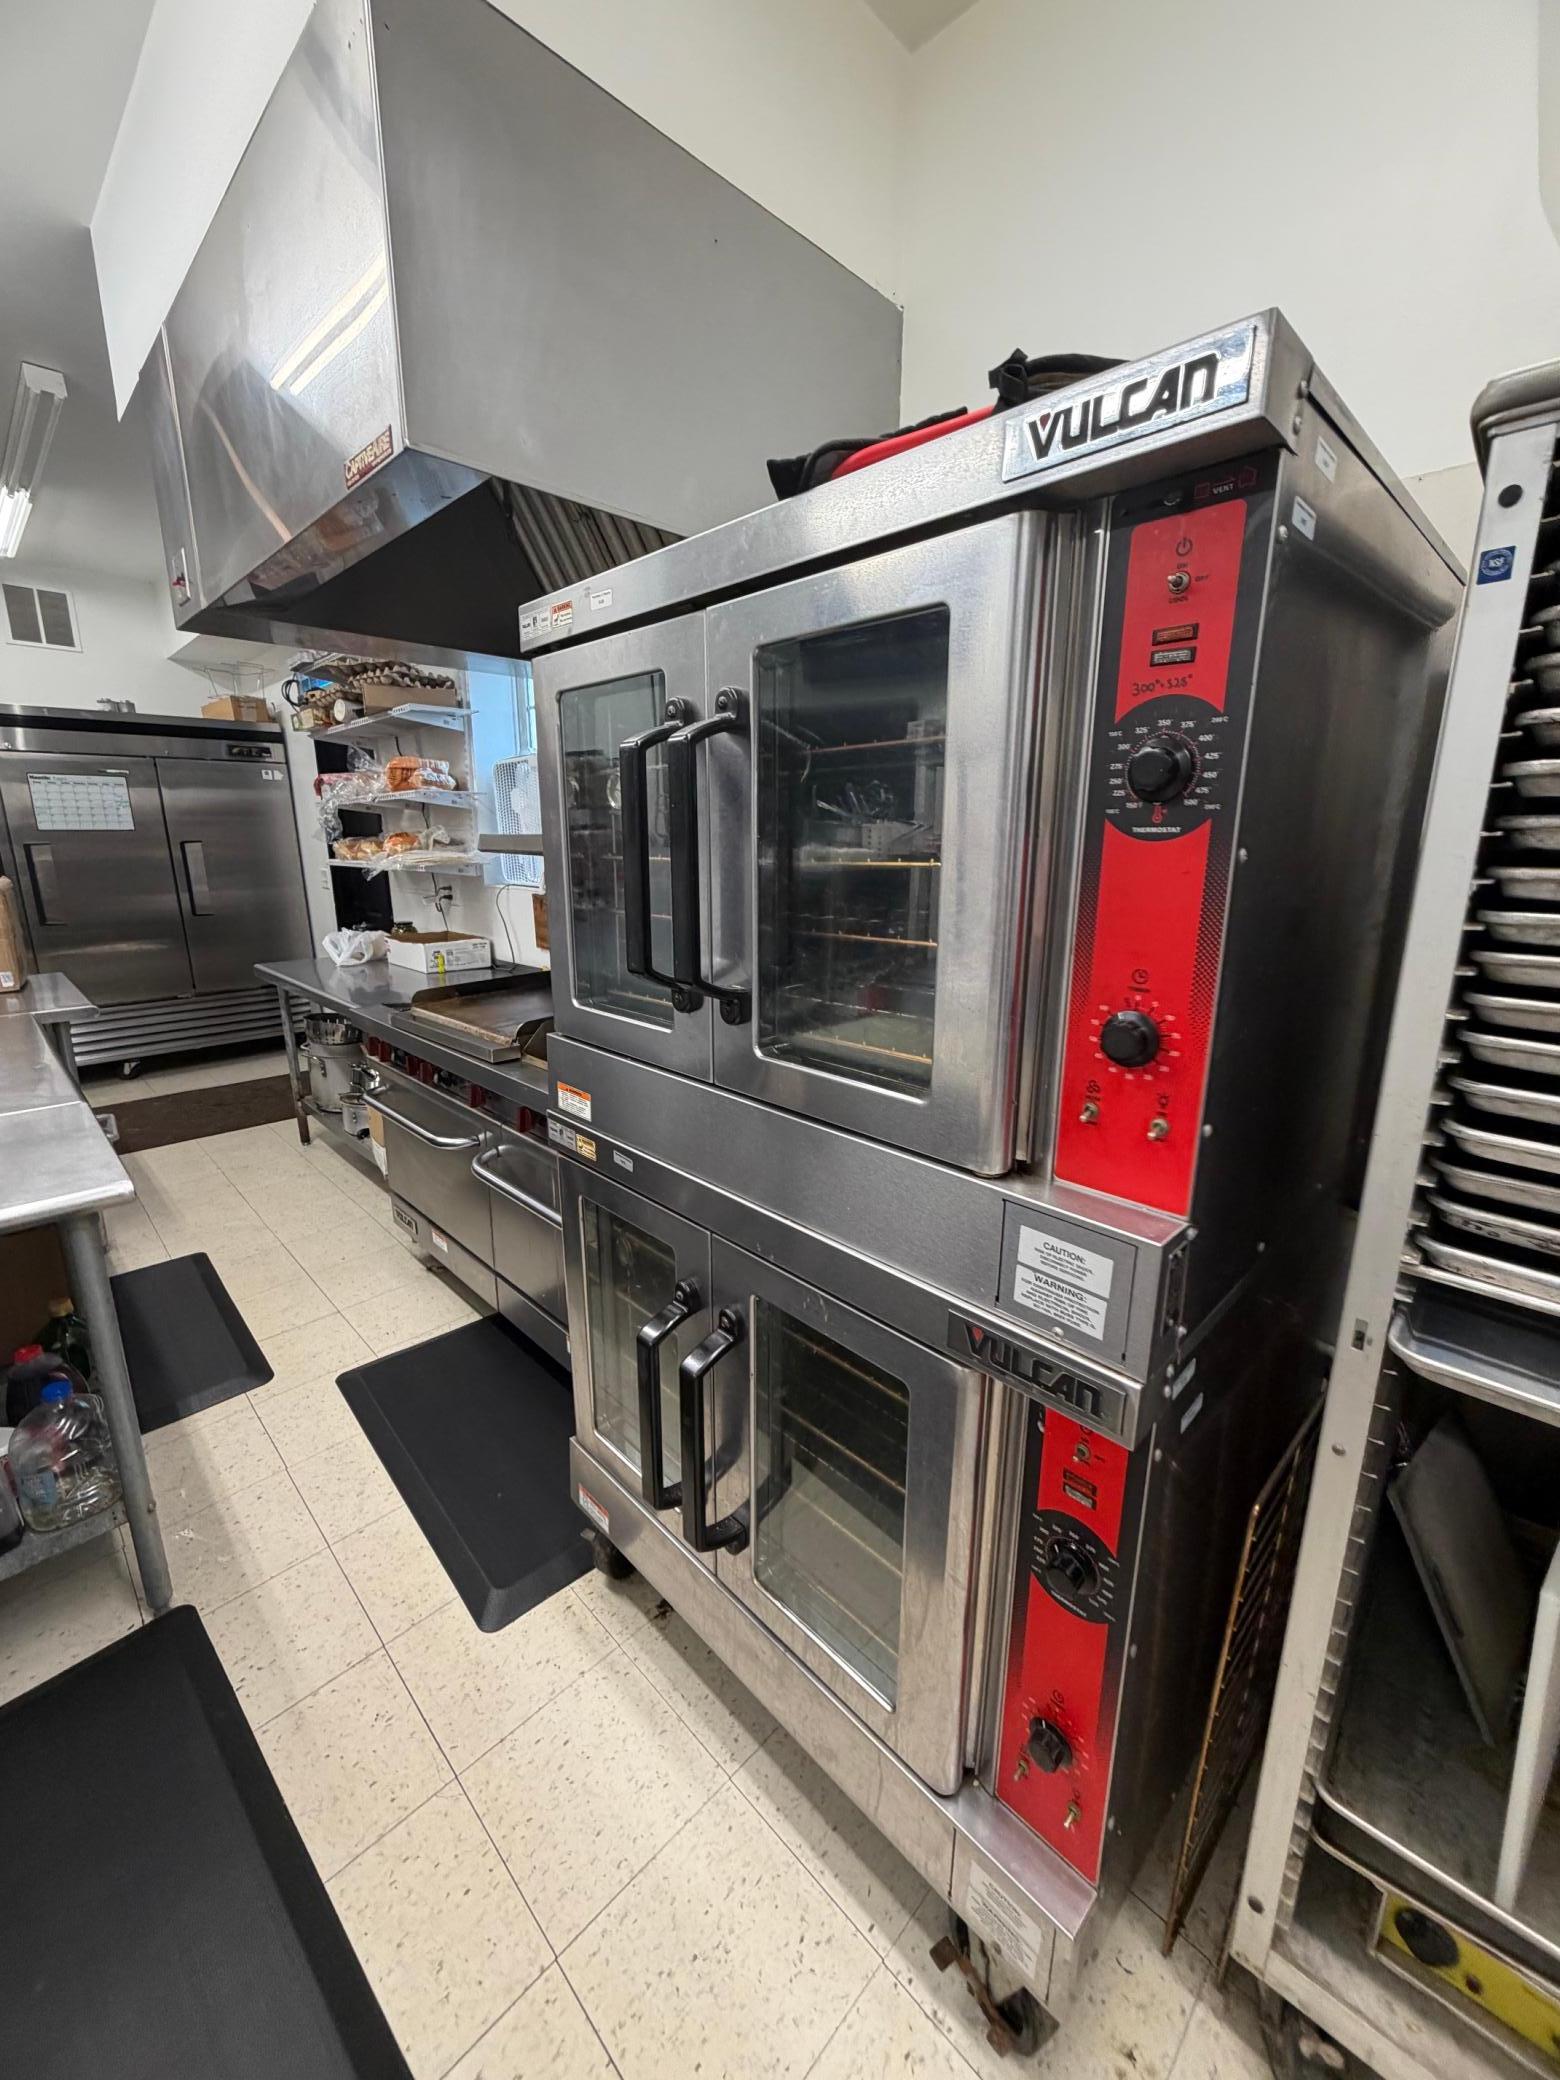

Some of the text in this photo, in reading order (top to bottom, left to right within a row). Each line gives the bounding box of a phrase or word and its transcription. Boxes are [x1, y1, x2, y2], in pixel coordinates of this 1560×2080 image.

[1028, 352, 1219, 460] VULCAN
[1042, 1241, 1086, 1264] CAUTION:
[1033, 1273, 1088, 1304] WARNING:
[964, 1322, 1102, 1418] VULCAN
